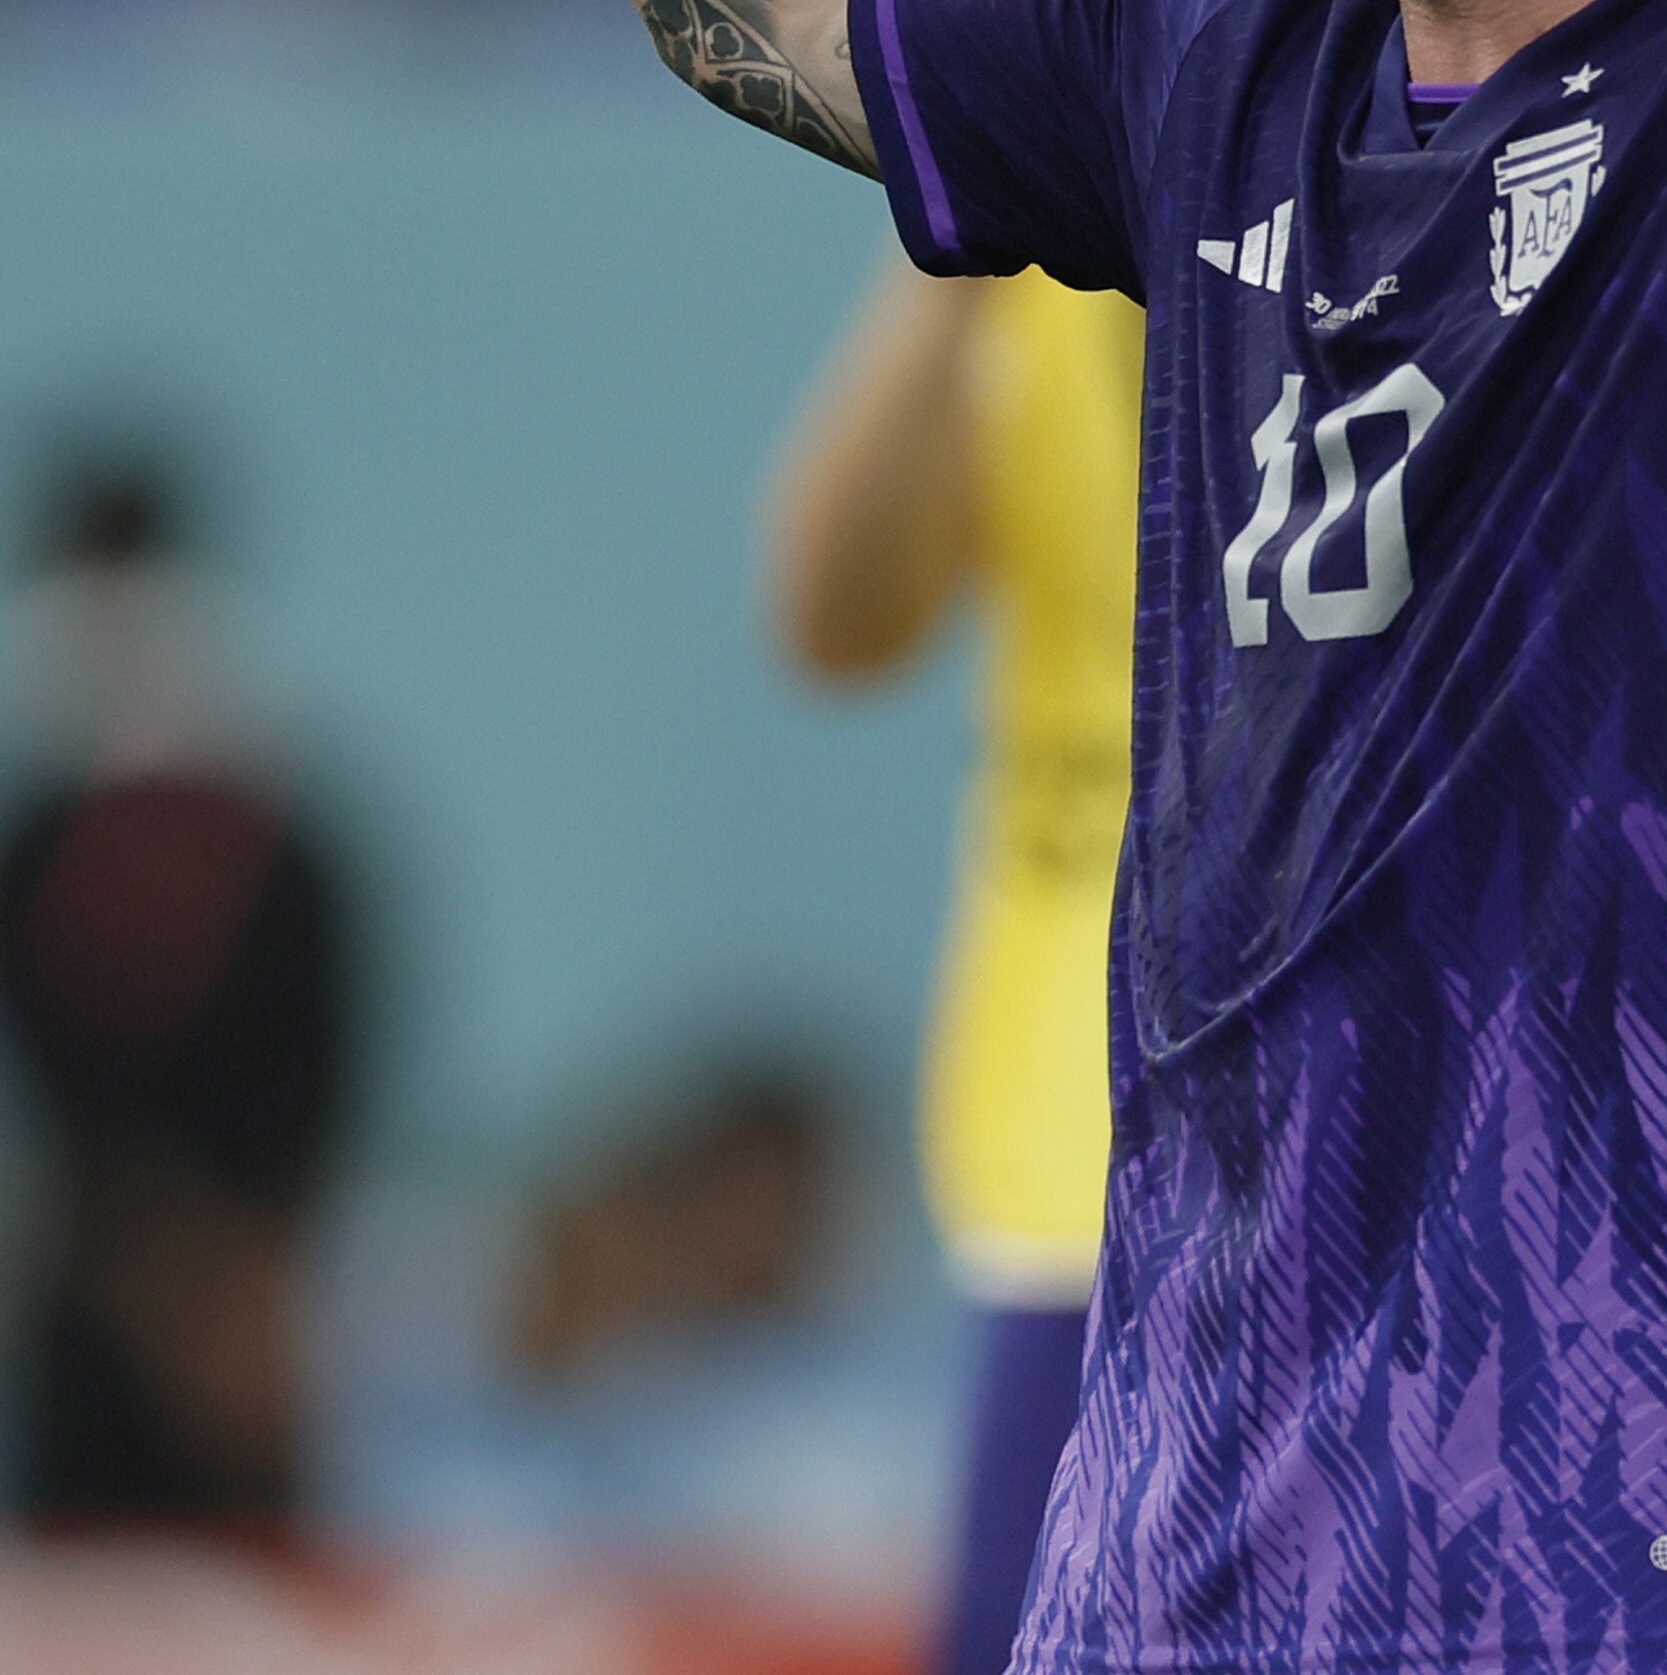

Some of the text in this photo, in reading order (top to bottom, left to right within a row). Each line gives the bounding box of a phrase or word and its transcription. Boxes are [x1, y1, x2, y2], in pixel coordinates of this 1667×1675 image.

[1518, 177, 1575, 259] AFA
[1305, 291, 1332, 314] 30
[1222, 362, 1446, 648] 10
